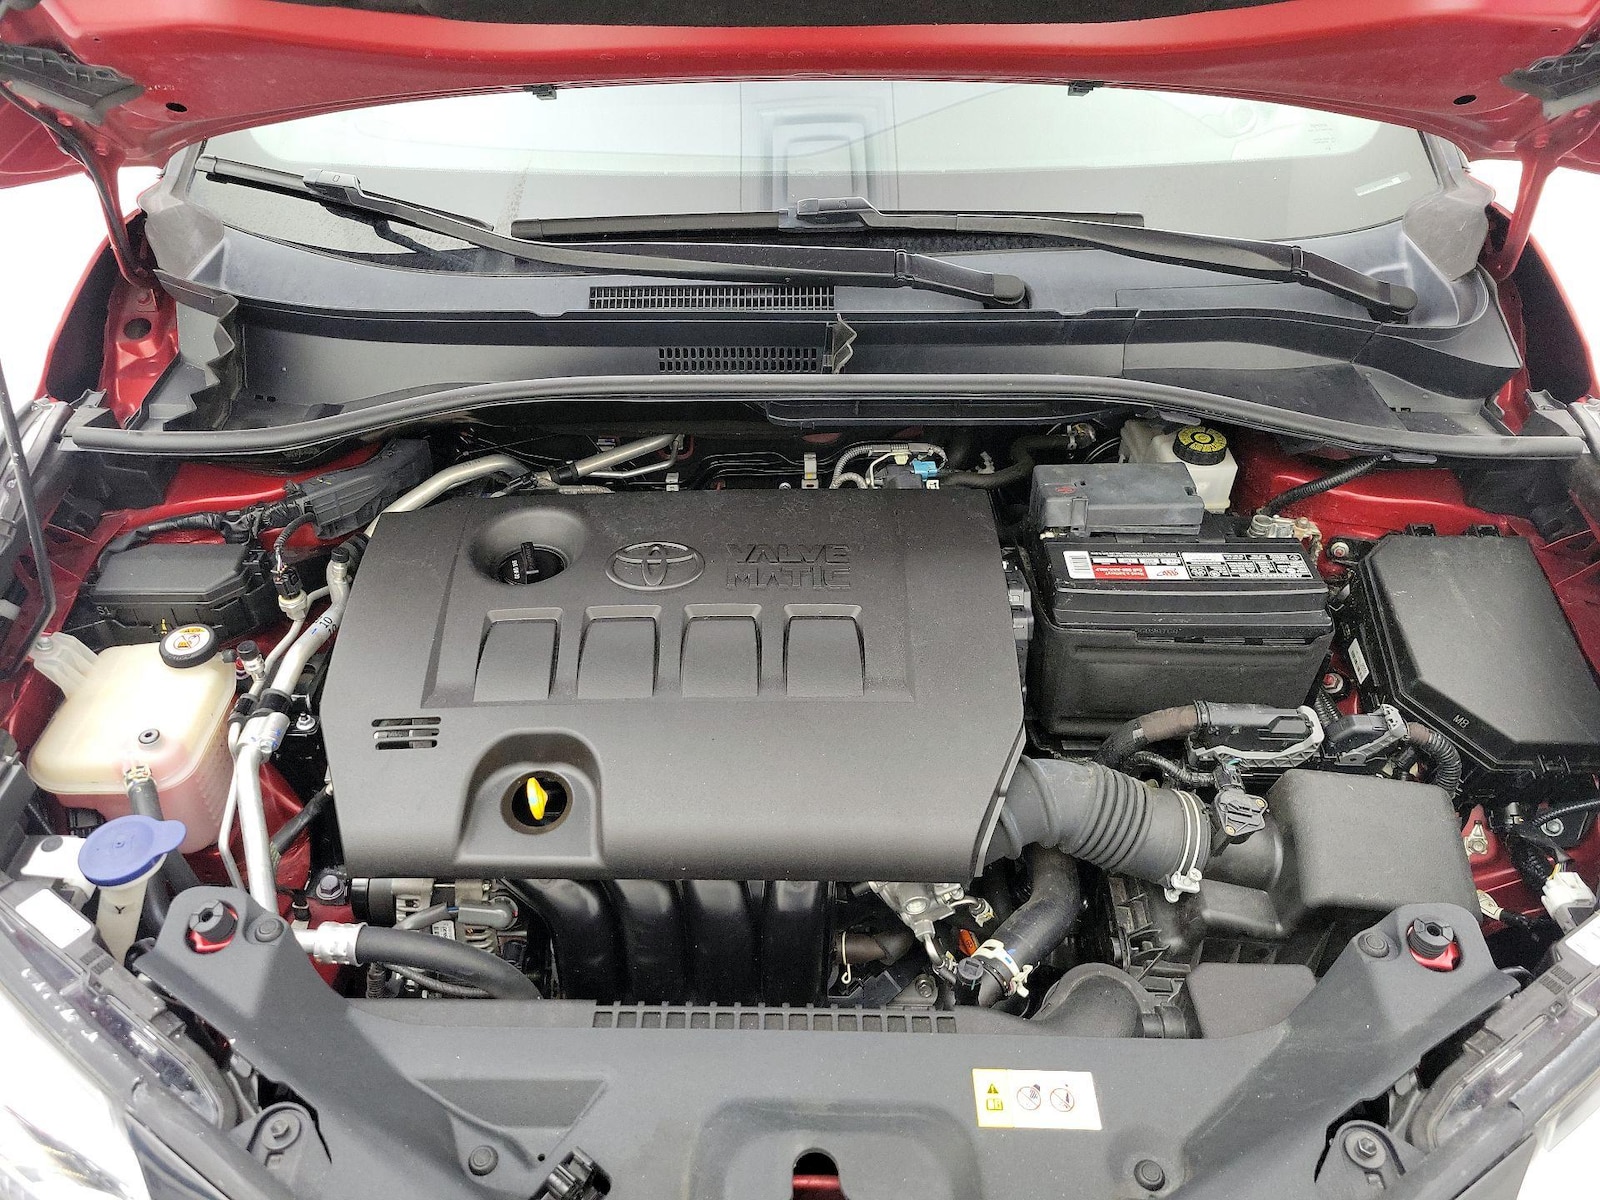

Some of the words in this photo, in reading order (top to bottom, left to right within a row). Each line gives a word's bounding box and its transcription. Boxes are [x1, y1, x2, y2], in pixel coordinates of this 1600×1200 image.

[726, 543, 850, 564] VALVE
[726, 565, 850, 589] MATIC
[320, 616, 333, 629] 10
